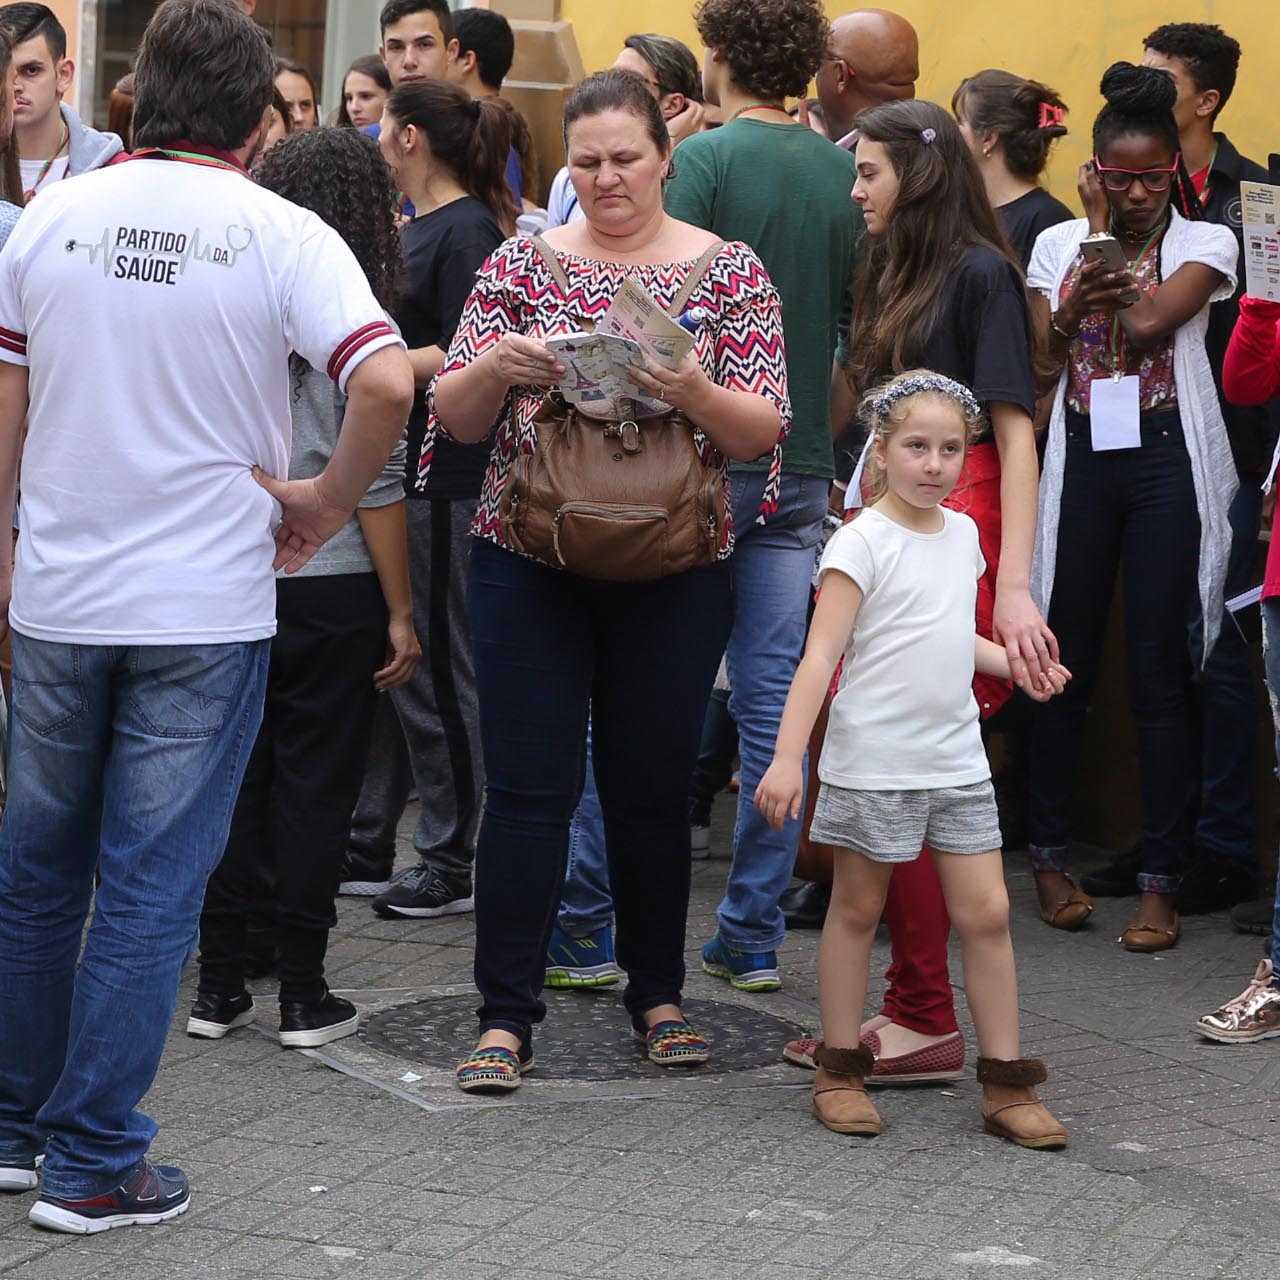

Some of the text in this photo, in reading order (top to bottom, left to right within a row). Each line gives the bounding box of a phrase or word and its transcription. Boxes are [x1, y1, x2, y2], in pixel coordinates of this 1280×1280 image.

[116, 226, 187, 254] PARTIDO
[114, 253, 179, 285] SAÚDE
[213, 247, 229, 263] DA
